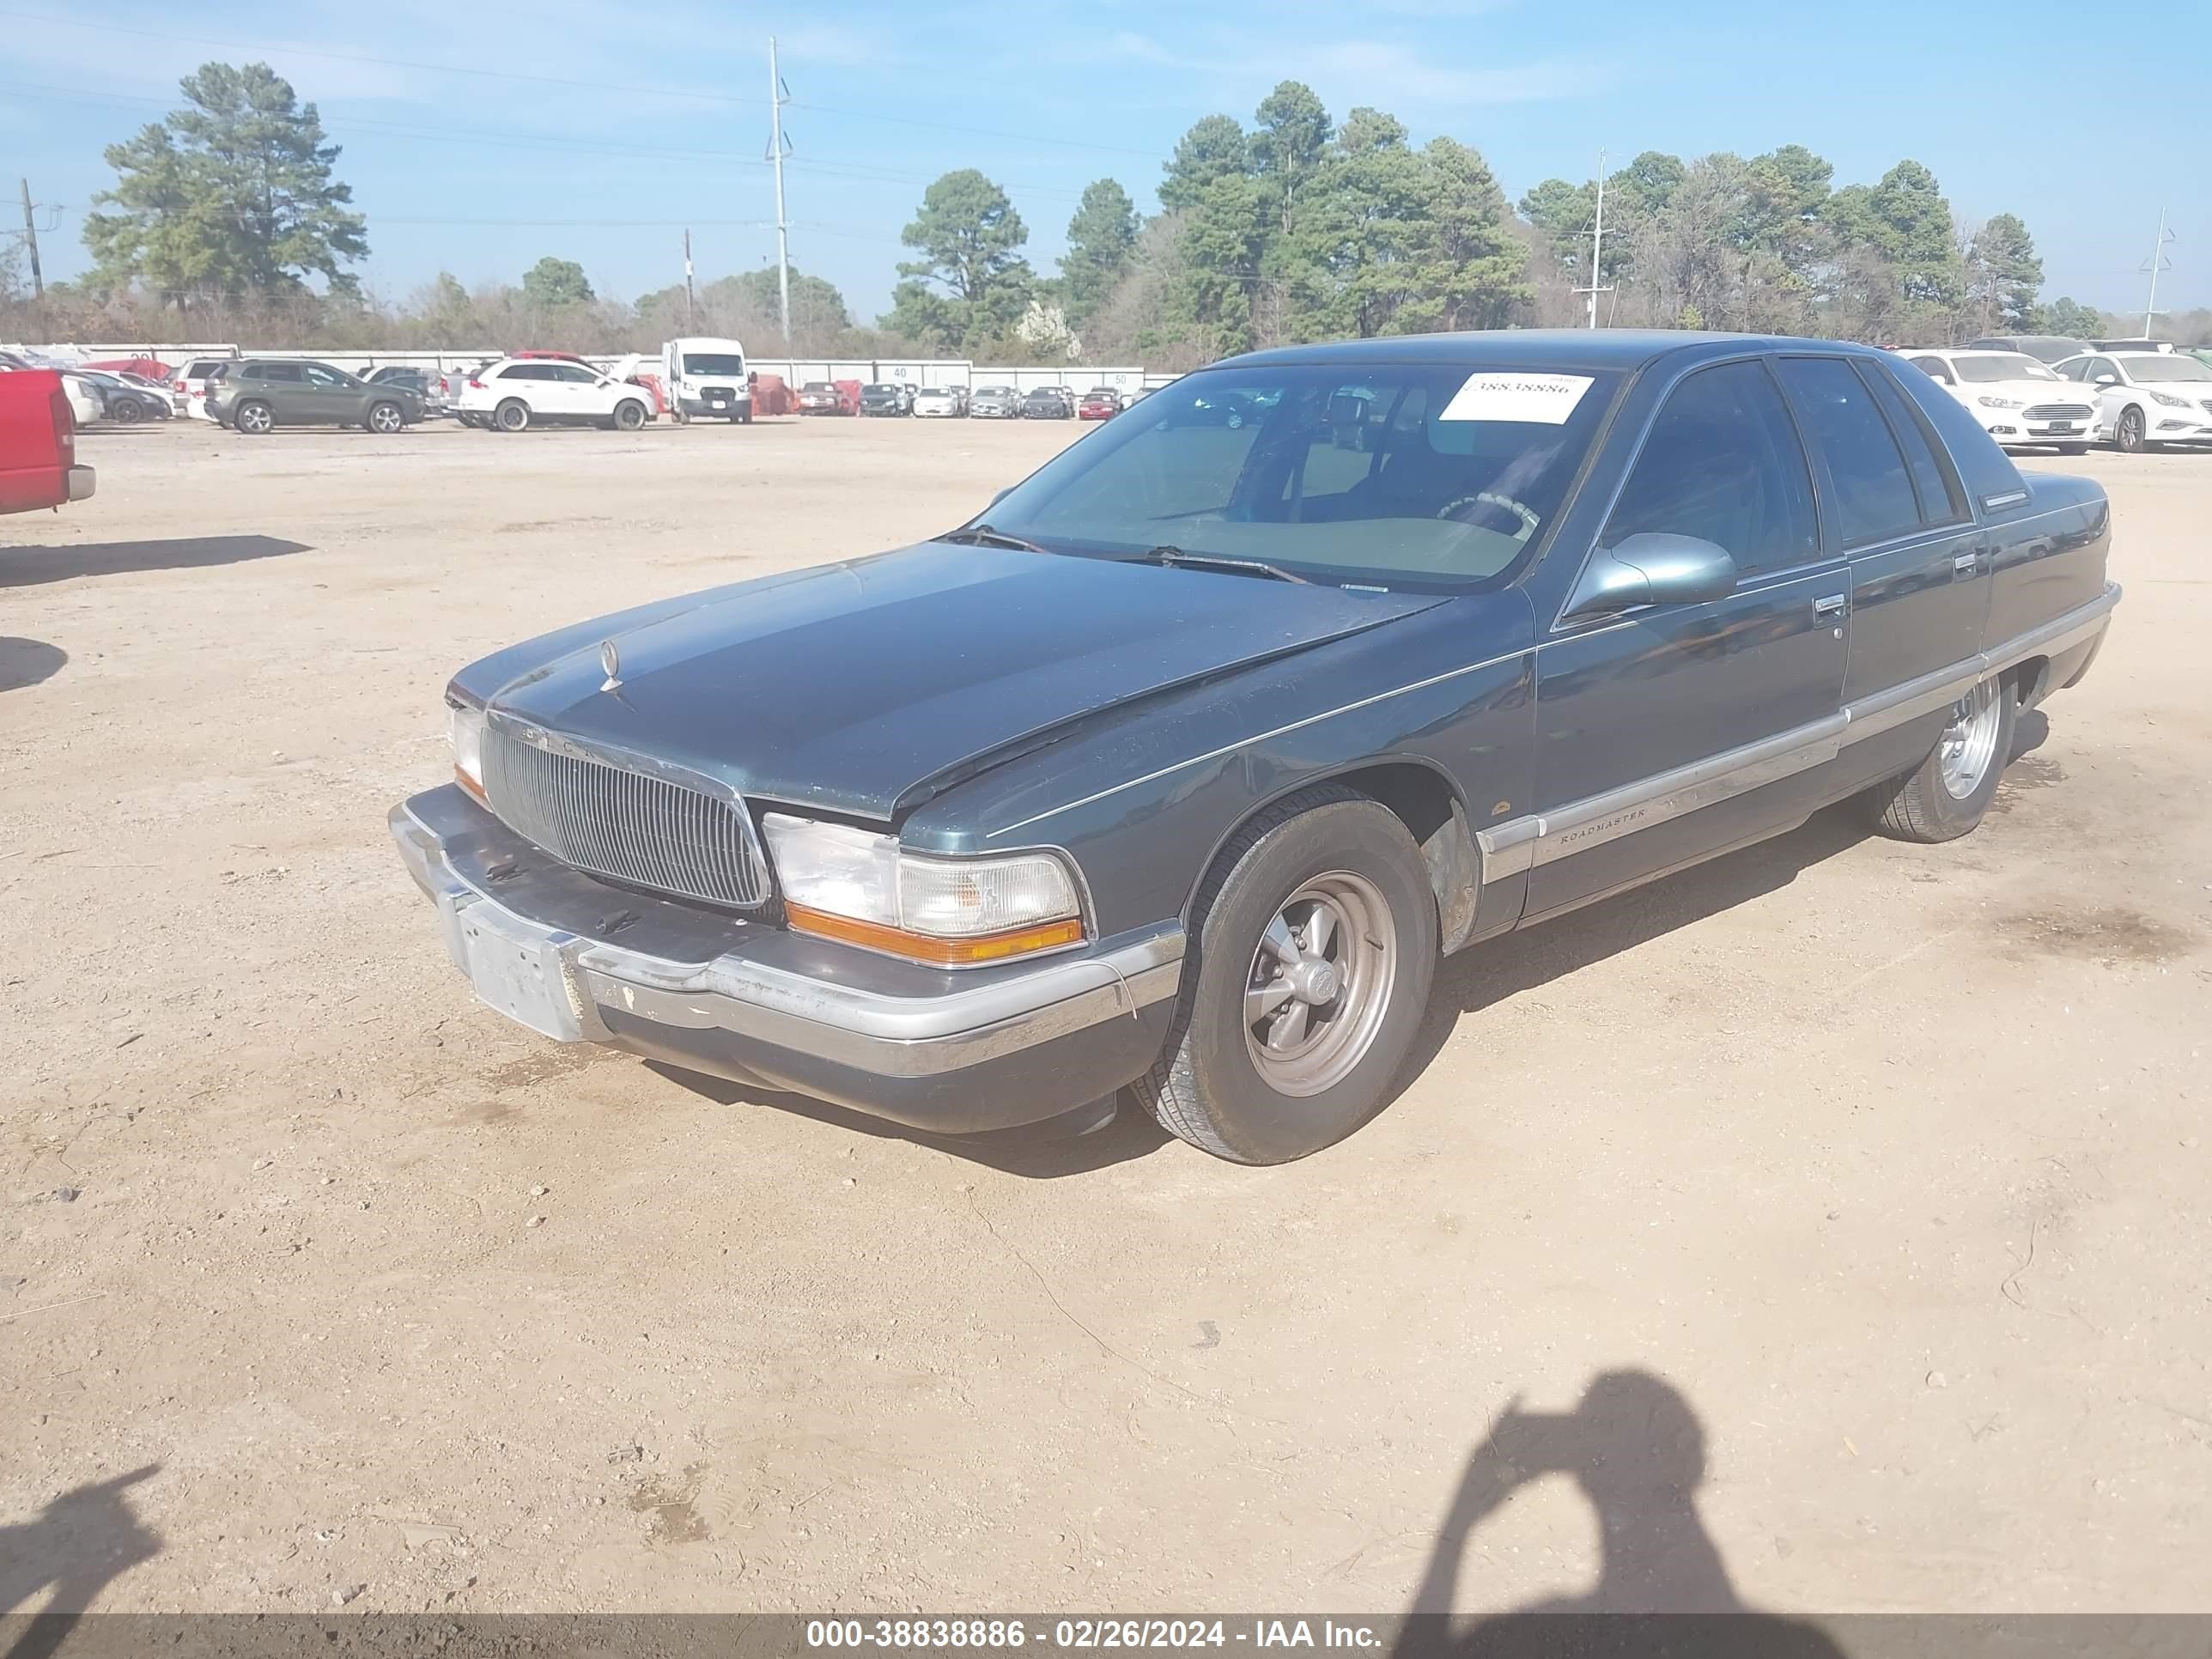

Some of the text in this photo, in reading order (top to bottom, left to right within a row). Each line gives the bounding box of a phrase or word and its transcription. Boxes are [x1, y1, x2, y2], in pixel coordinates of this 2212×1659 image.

[894, 368, 906, 378] 40
[1115, 374, 1126, 385] 50
[1559, 809, 1645, 844] ROADMASTER
